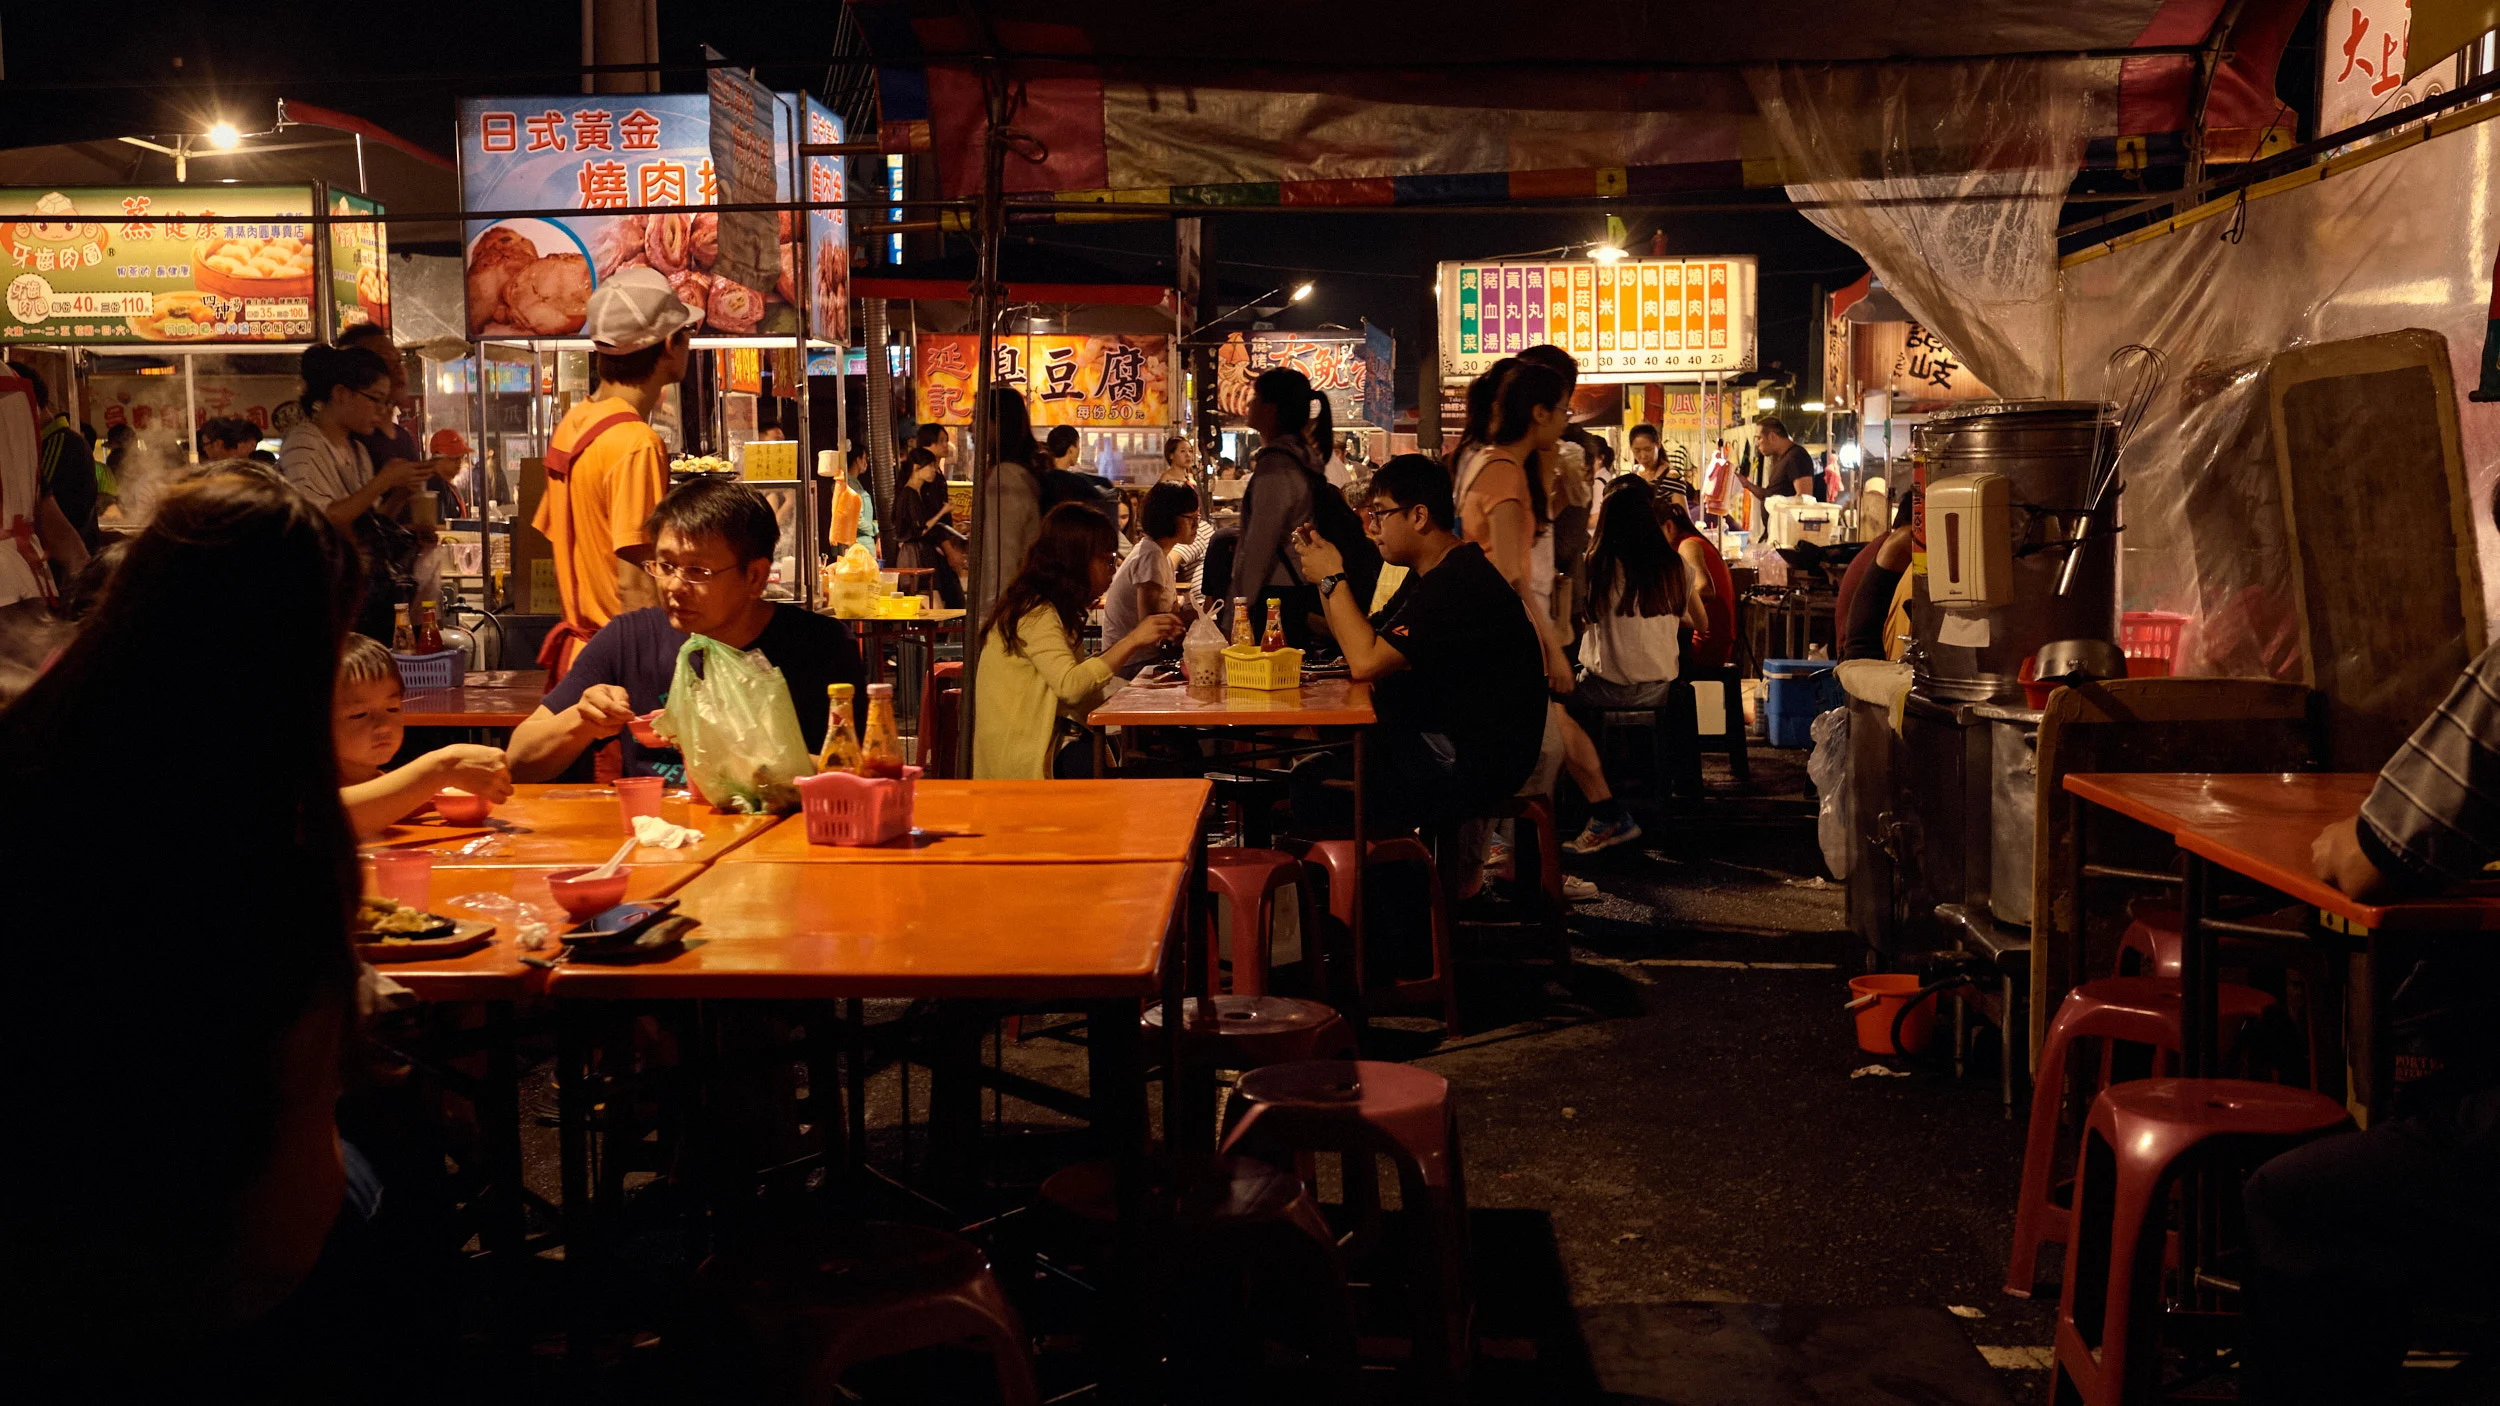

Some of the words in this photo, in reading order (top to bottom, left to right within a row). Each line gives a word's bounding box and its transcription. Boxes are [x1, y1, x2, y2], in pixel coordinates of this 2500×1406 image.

[479, 108, 661, 154] 日式黃金
[120, 196, 218, 240] 蒸健康
[12, 241, 103, 271] 牙齒肉圓
[1483, 272, 1499, 350] 豬血湯
[1506, 271, 1521, 350] 貢丸湯
[1528, 271, 1544, 346] 魚丸湯
[1598, 268, 1614, 348] 炒米粉
[1251, 337, 1269, 369] 燒烤
[1463, 361, 1478, 371] 30
[1599, 357, 1613, 366] 30
[1622, 357, 1636, 366] 30
[1644, 357, 1658, 366] 40
[1665, 357, 1679, 366] 40
[1688, 356, 1702, 364] 40
[1711, 354, 1724, 363] 25
[926, 342, 971, 417] 延記
[1076, 404, 1145, 420] 每份50元
